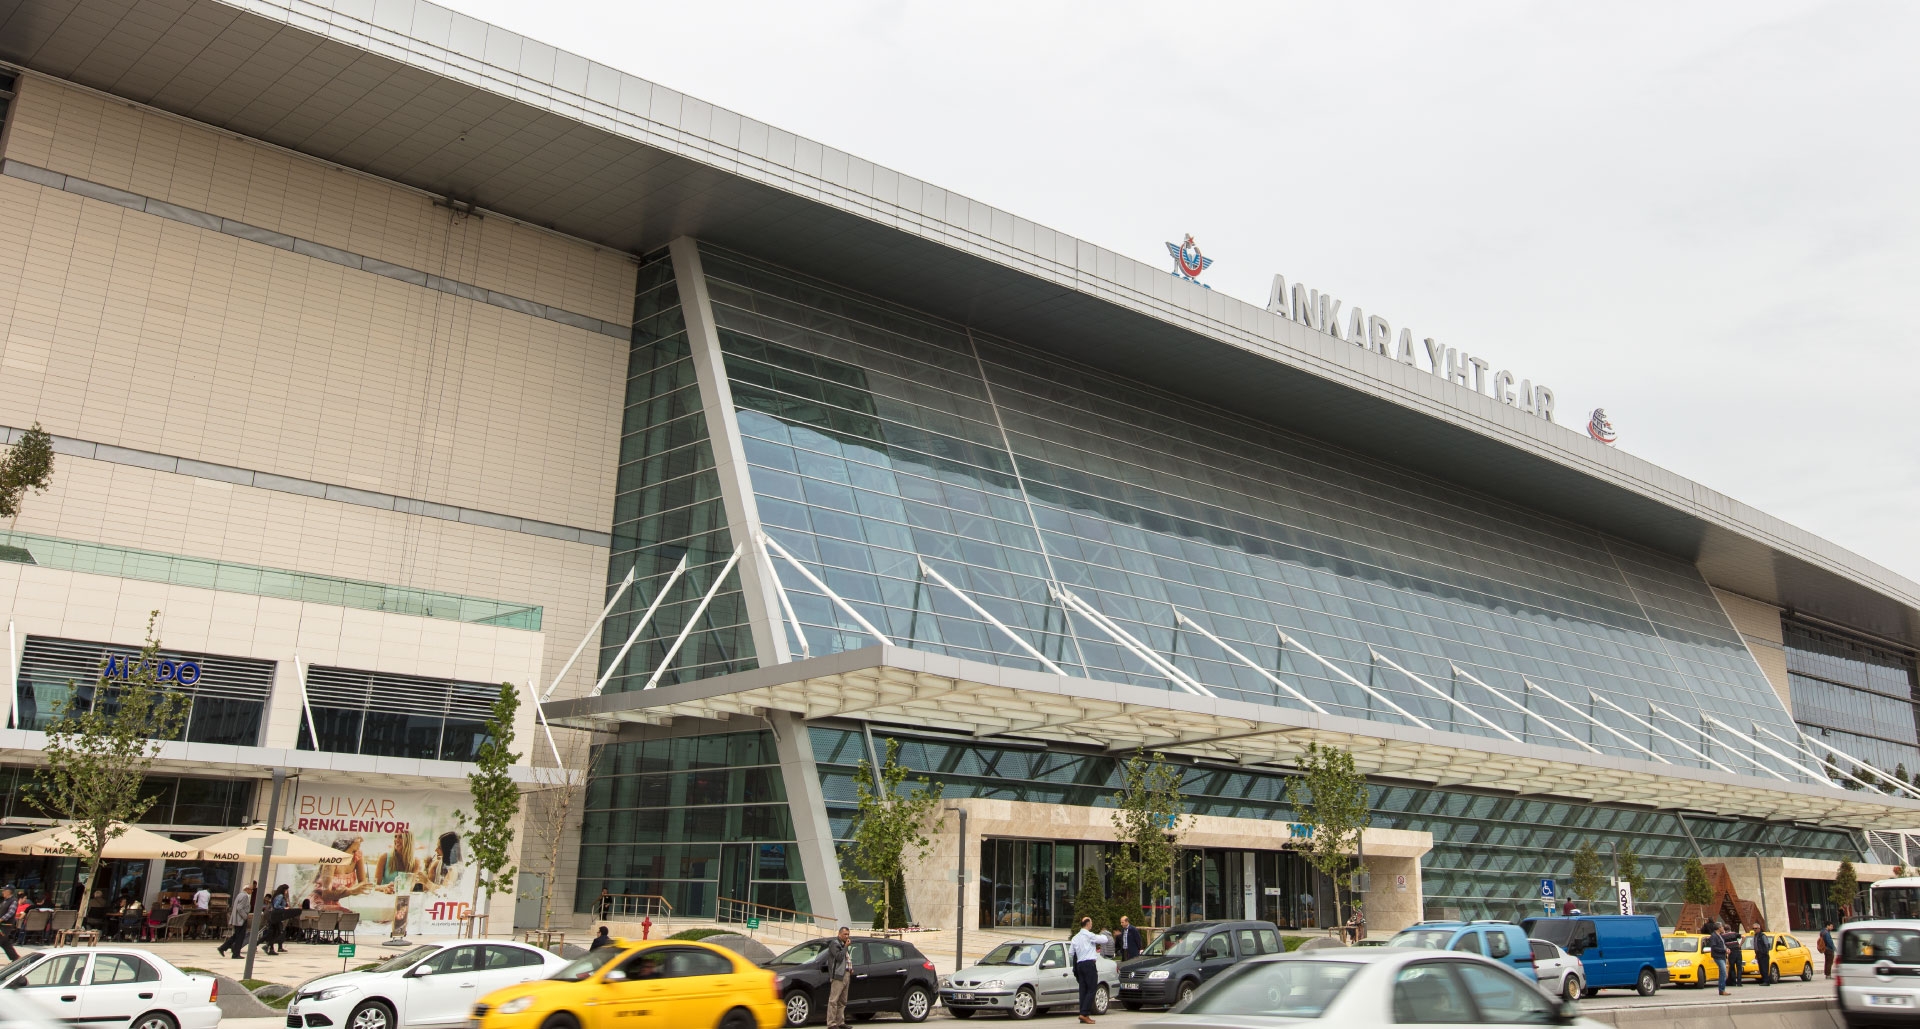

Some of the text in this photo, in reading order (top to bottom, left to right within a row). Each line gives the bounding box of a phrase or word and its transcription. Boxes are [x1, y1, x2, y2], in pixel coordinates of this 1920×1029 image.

[1267, 273, 1555, 424] ANKARA YHT GAR
[300, 795, 395, 818] BULVAR
[298, 817, 409, 834] RENKLENİYOR!
[44, 847, 76, 855] MAD
[160, 850, 188, 858] MADO
[213, 852, 240, 860] MADO
[425, 901, 473, 920] ATG
[1620, 889, 1629, 916] MADO
